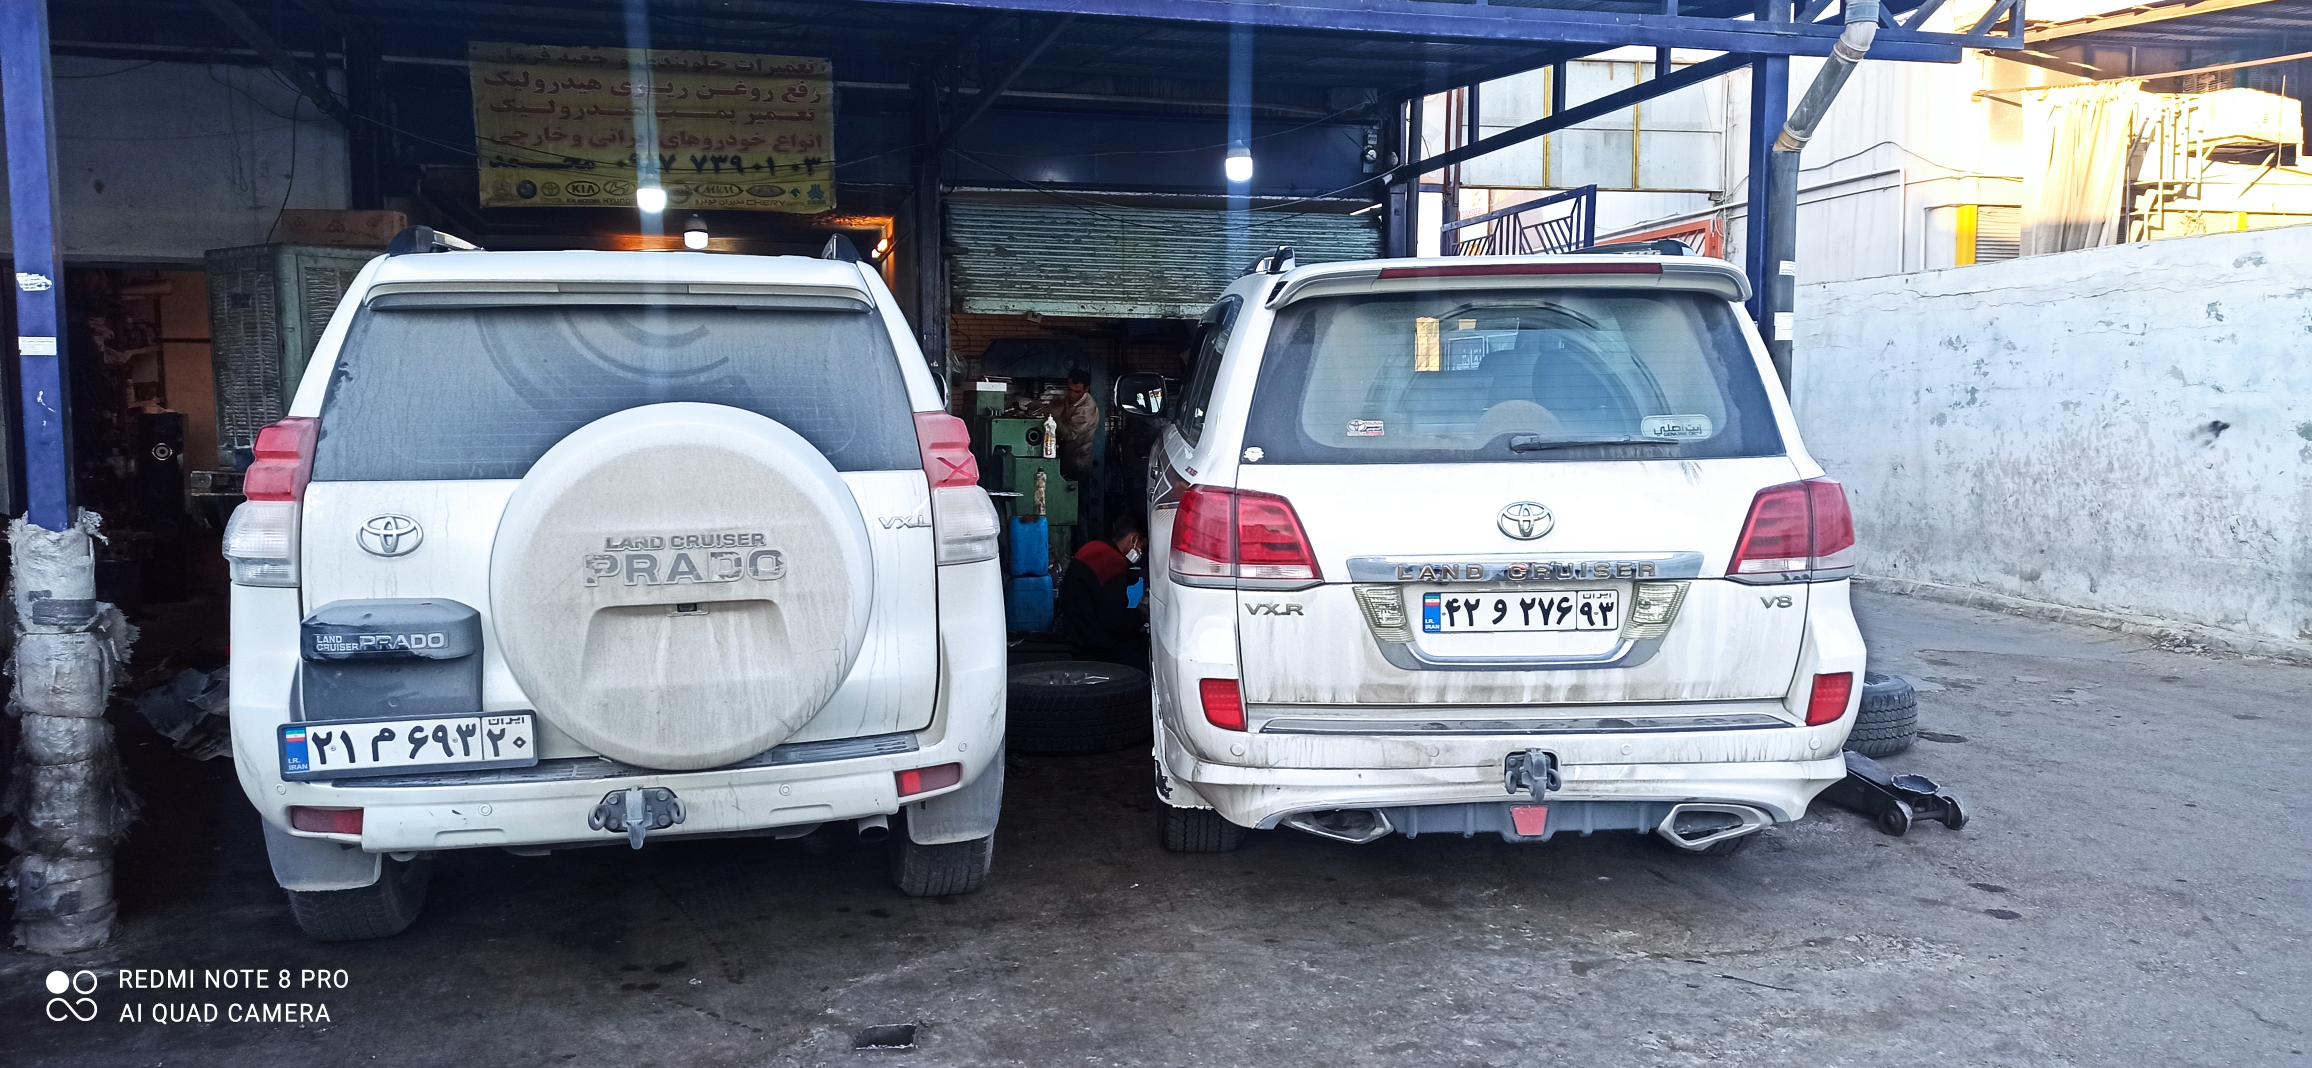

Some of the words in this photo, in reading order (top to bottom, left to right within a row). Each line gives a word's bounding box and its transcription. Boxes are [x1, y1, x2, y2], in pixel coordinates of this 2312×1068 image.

[484, 70, 602, 94] هیدرولیک
[696, 81, 774, 103] روغن
[781, 81, 821, 103] رفع
[744, 108, 815, 125] تعمیر
[659, 130, 766, 152] خودروهای
[774, 134, 822, 153] انواع
[572, 184, 595, 193] KIA
[605, 536, 664, 551] LAND
[670, 533, 766, 550] CRUISER
[583, 549, 788, 587] PRADO
[1397, 563, 1485, 581] LAND
[1507, 561, 1657, 580] CRUISER
[1582, 592, 1613, 600] ایران
[1760, 595, 1793, 609] V8
[1580, 601, 1615, 627] ۹۳
[316, 635, 343, 644] LAND
[316, 642, 360, 652] CRUISER
[359, 633, 446, 651] PRADO
[486, 727, 527, 758] ۲۰
[288, 763, 308, 771] IRAN
